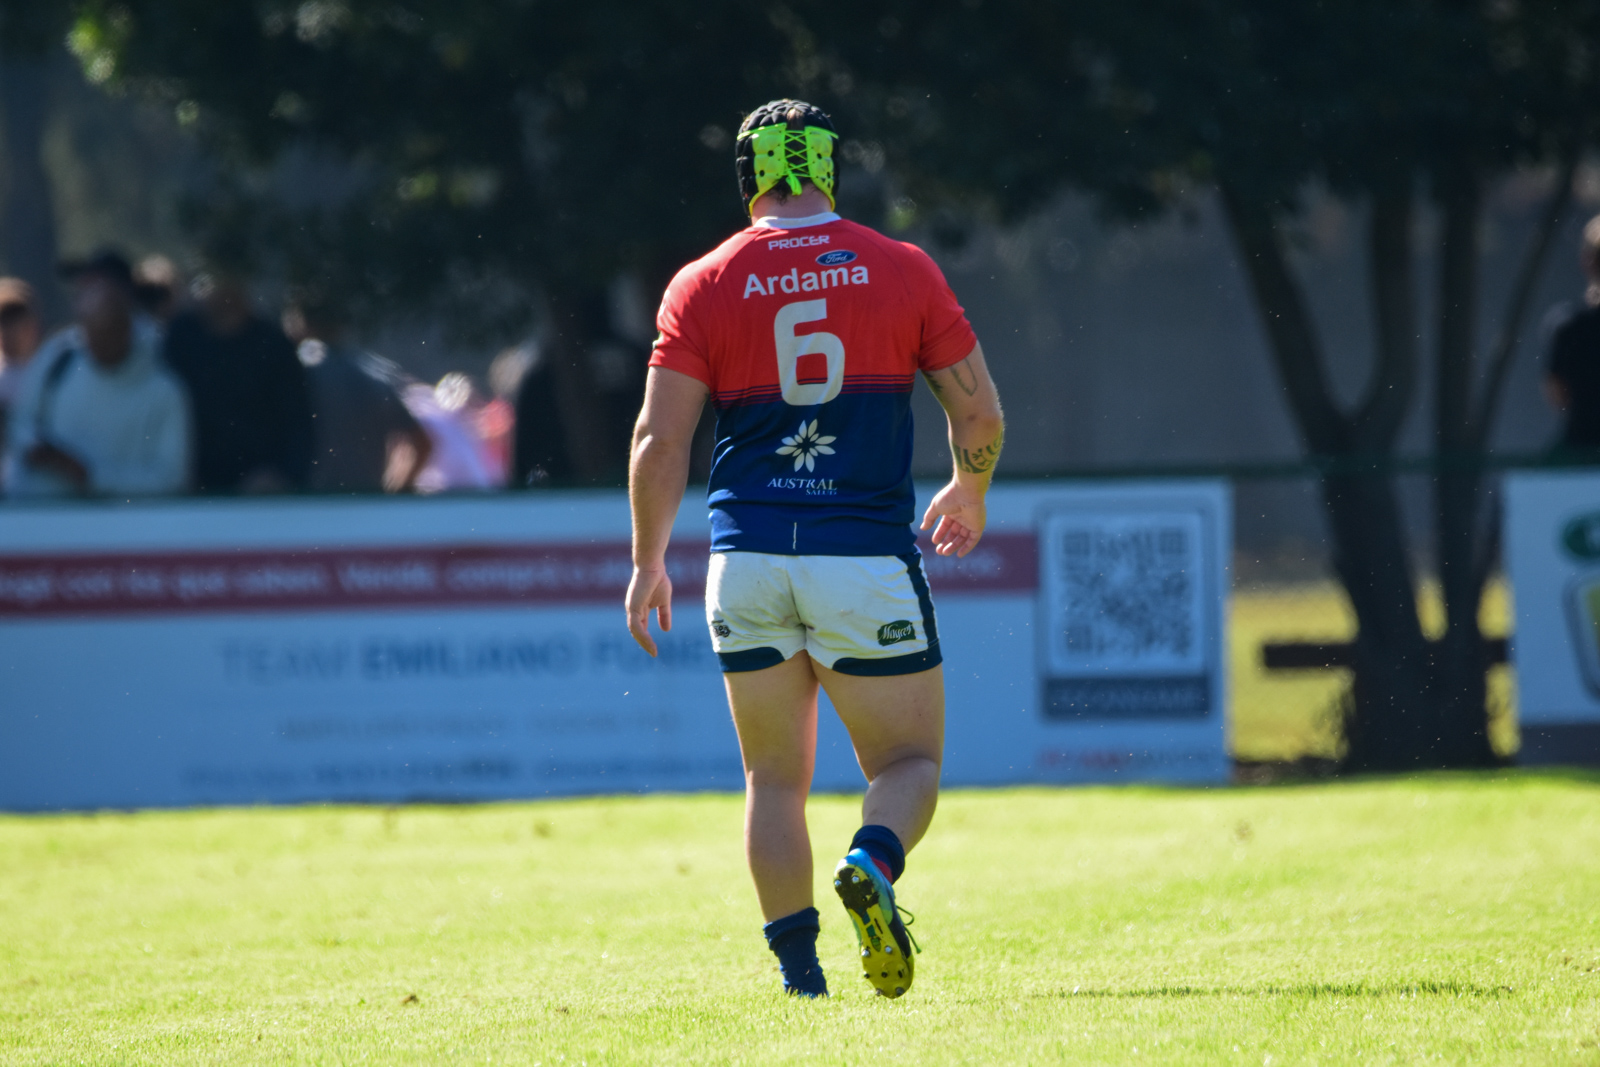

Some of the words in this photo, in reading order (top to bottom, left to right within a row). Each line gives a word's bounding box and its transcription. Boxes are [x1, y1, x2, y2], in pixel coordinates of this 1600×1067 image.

[768, 235, 830, 251] PROCER
[743, 266, 869, 299] Ardama
[773, 298, 846, 406] 6
[767, 478, 838, 491] AUSTRAL
[219, 638, 348, 684] TEAM
[360, 632, 582, 680] EMILIANO
